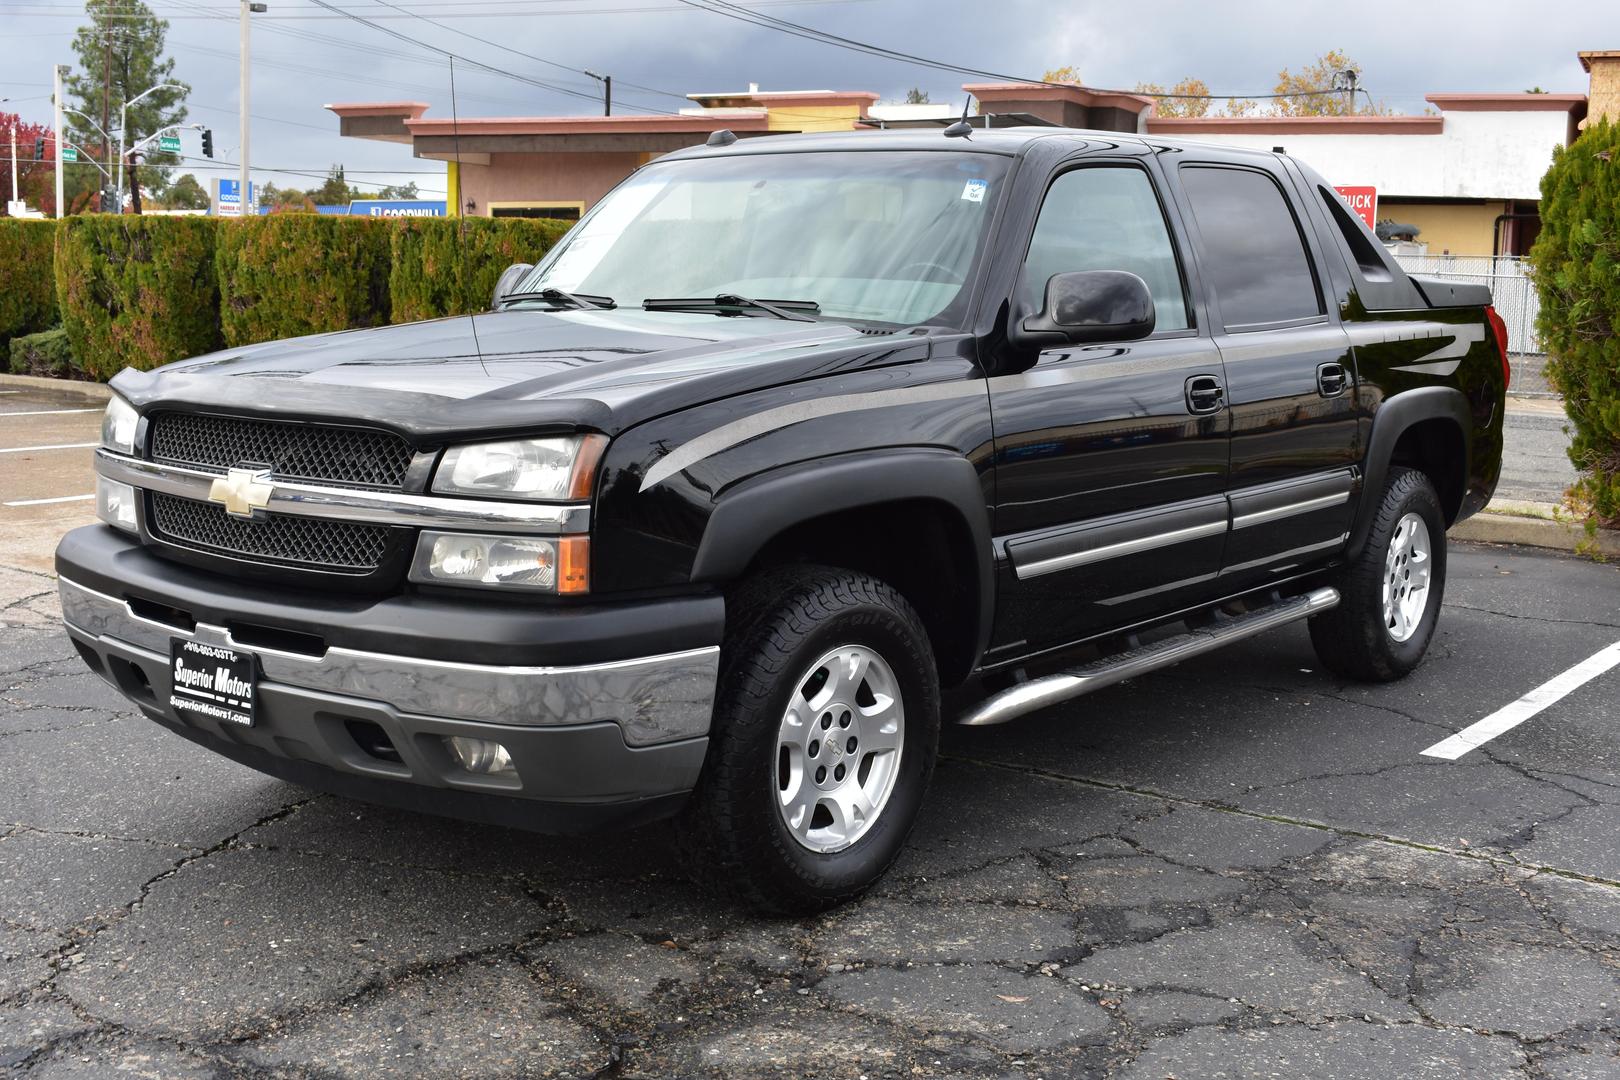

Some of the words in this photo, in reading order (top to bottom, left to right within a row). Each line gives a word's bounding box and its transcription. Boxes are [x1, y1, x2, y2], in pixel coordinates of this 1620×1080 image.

[1340, 194, 1372, 209] RUCK
[174, 657, 214, 689] Superior
[214, 666, 252, 698] Motors
[169, 695, 251, 725] SuperiorMotors1.com
